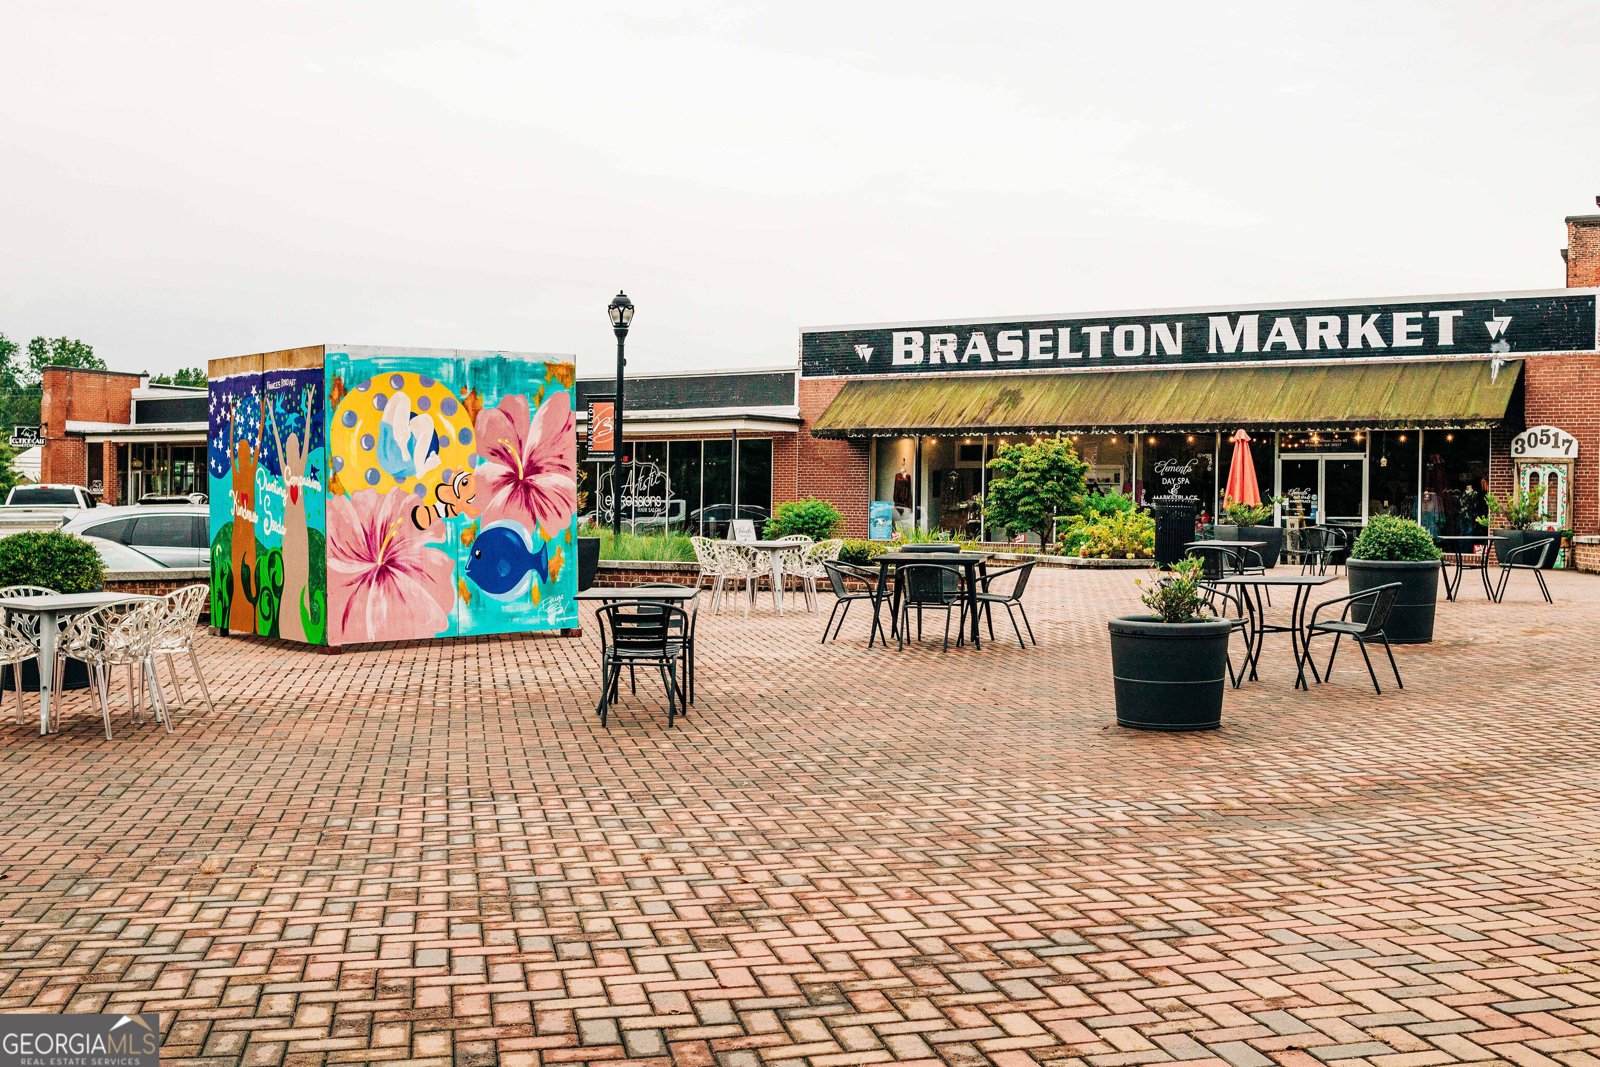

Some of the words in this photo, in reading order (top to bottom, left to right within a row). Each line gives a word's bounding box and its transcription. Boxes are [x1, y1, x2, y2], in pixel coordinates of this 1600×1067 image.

[892, 322, 1183, 366] BRASELTON
[1207, 309, 1464, 354] MARKET
[1514, 428, 1573, 455] 30517
[1154, 458, 1199, 476] Elements
[1162, 477, 1176, 485] DAY
[1177, 477, 1190, 485] SPA
[1168, 483, 1181, 495] &
